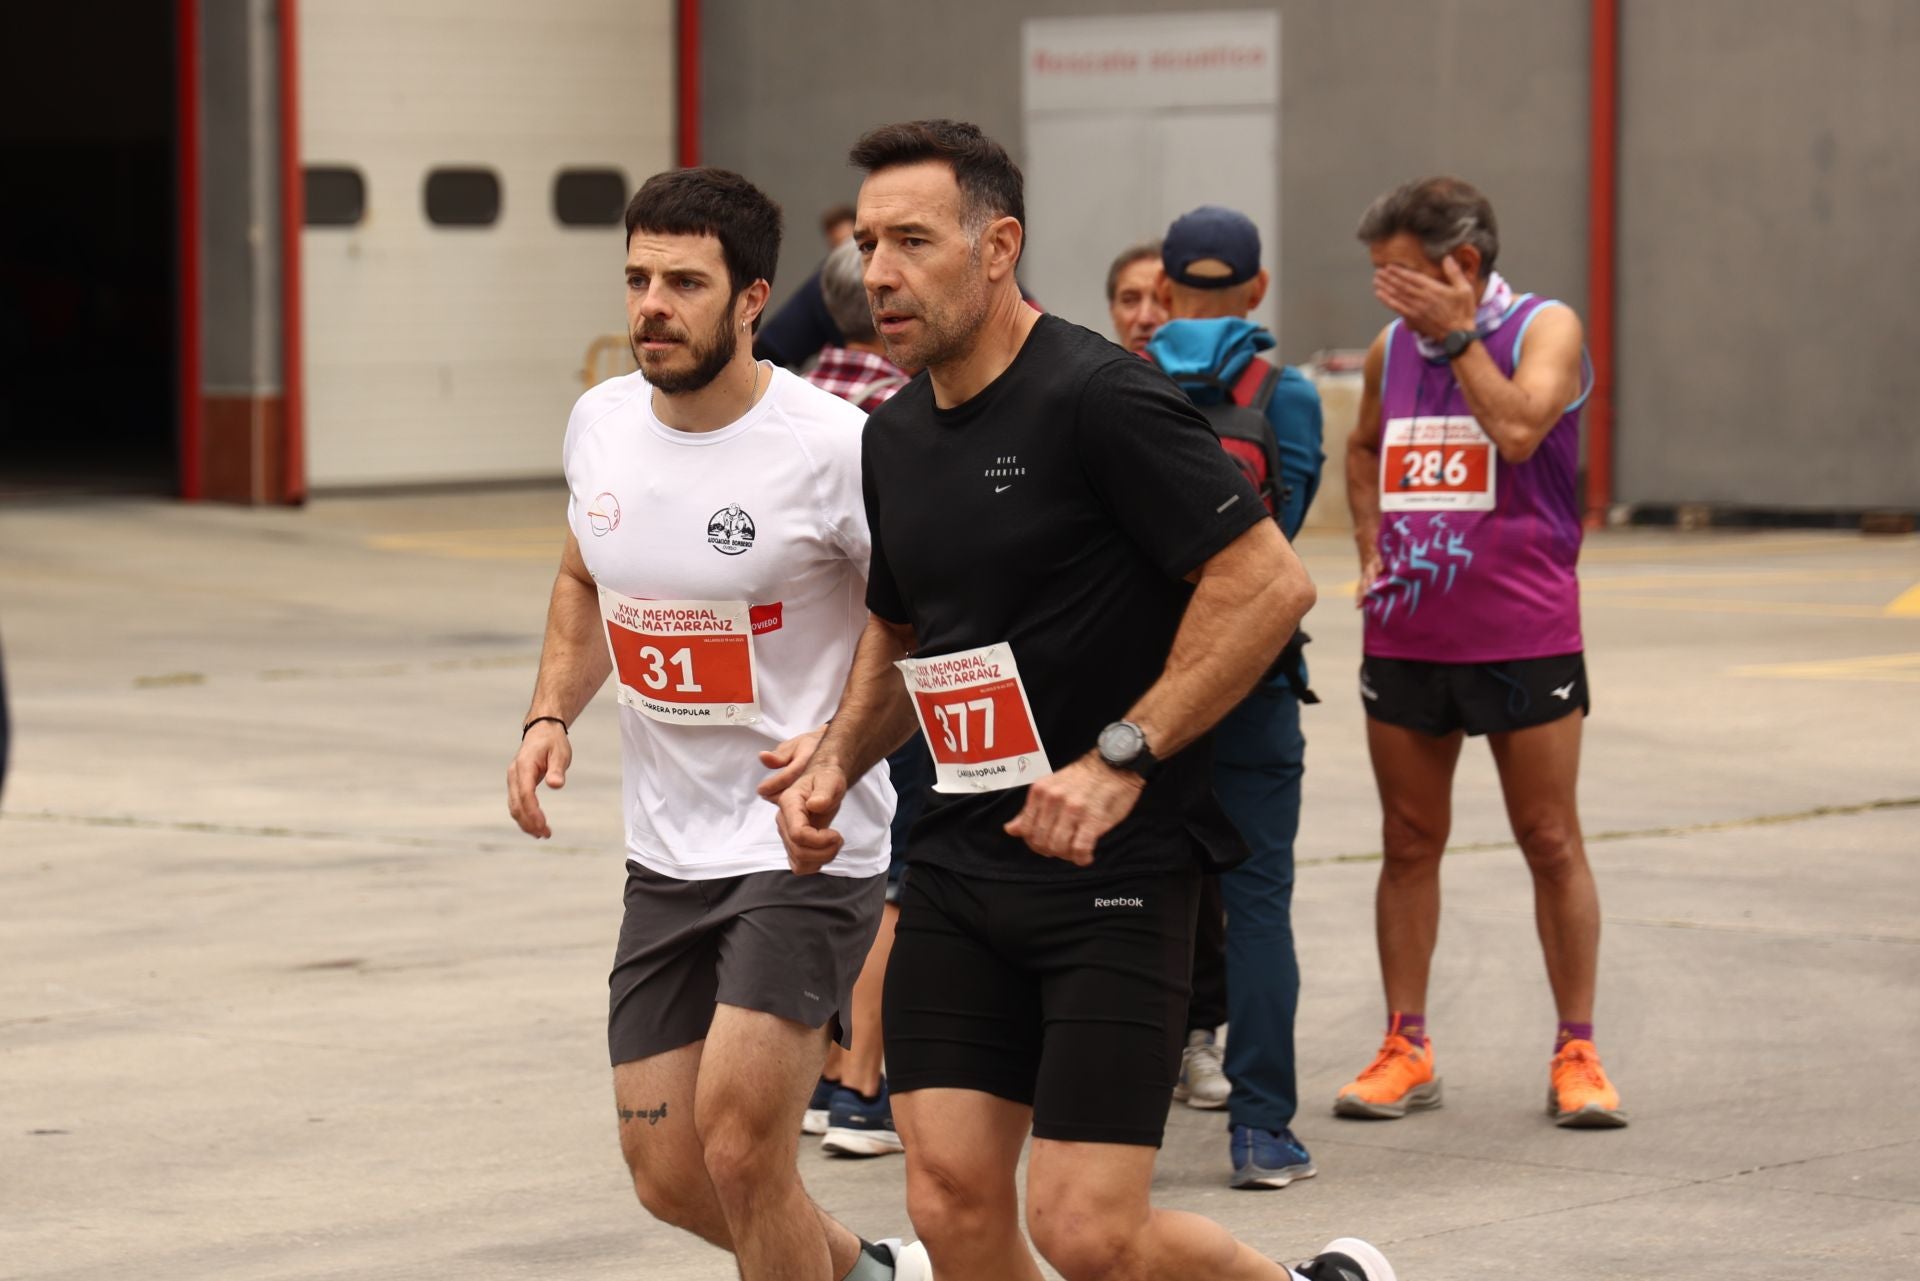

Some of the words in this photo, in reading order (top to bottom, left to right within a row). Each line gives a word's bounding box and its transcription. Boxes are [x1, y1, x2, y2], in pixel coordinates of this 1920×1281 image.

[997, 455, 1017, 464] NIKE
[1402, 450, 1468, 487] 286
[611, 609, 734, 632] VIDAL-MATARRANZ
[617, 602, 640, 619] XXIX
[642, 608, 718, 621] MEMORIAL
[751, 617, 778, 631] OVIEDO
[639, 645, 703, 693] 31
[929, 655, 986, 676] MEMORIAL
[641, 699, 671, 713] CARRERA
[671, 707, 711, 716] POPULAR
[933, 696, 995, 753] 377
[975, 764, 1006, 777] POPULAR
[1094, 897, 1144, 908] Reebok
